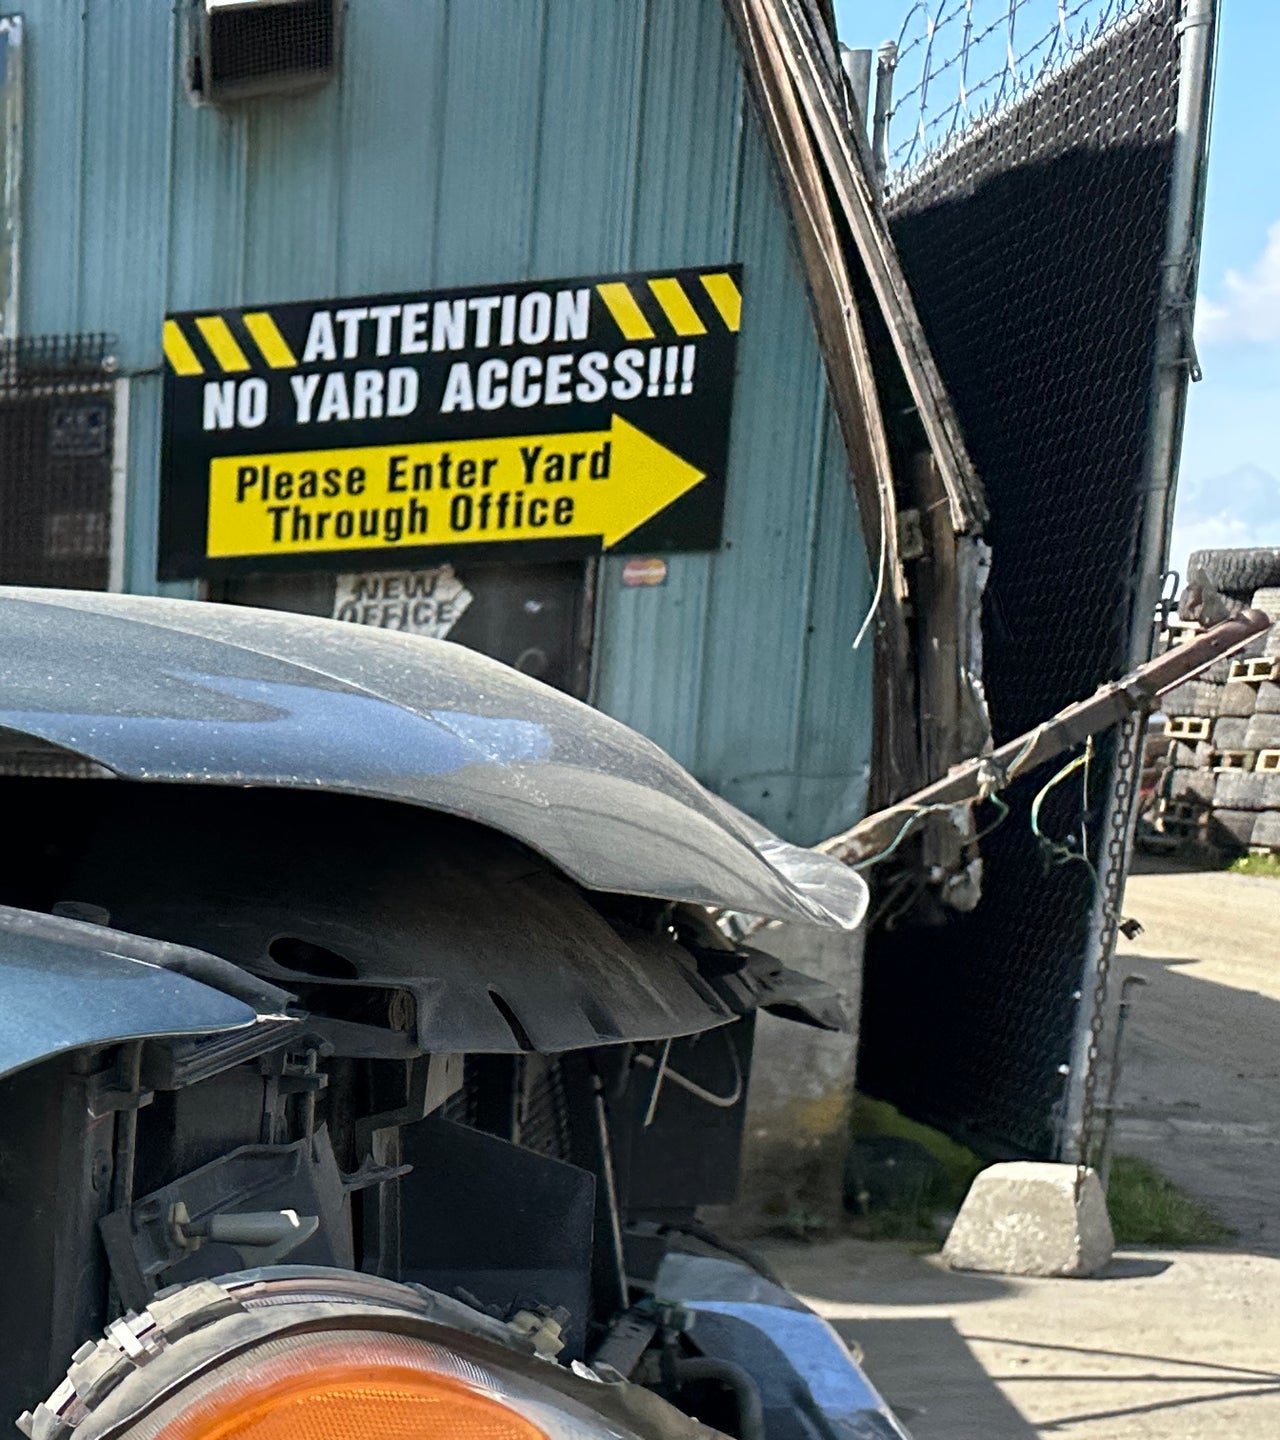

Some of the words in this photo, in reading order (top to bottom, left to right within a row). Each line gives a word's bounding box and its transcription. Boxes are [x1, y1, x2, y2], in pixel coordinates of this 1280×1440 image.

[301, 287, 591, 364] ATTENTION
[202, 376, 269, 431] NO
[290, 365, 420, 425] YARD
[439, 343, 697, 414] ACCESS!!!
[236, 464, 367, 503] Please
[387, 453, 499, 494] Enter
[519, 441, 613, 485] Yard
[266, 497, 430, 543] Through
[449, 489, 576, 532] Office
[351, 575, 438, 601] NEW
